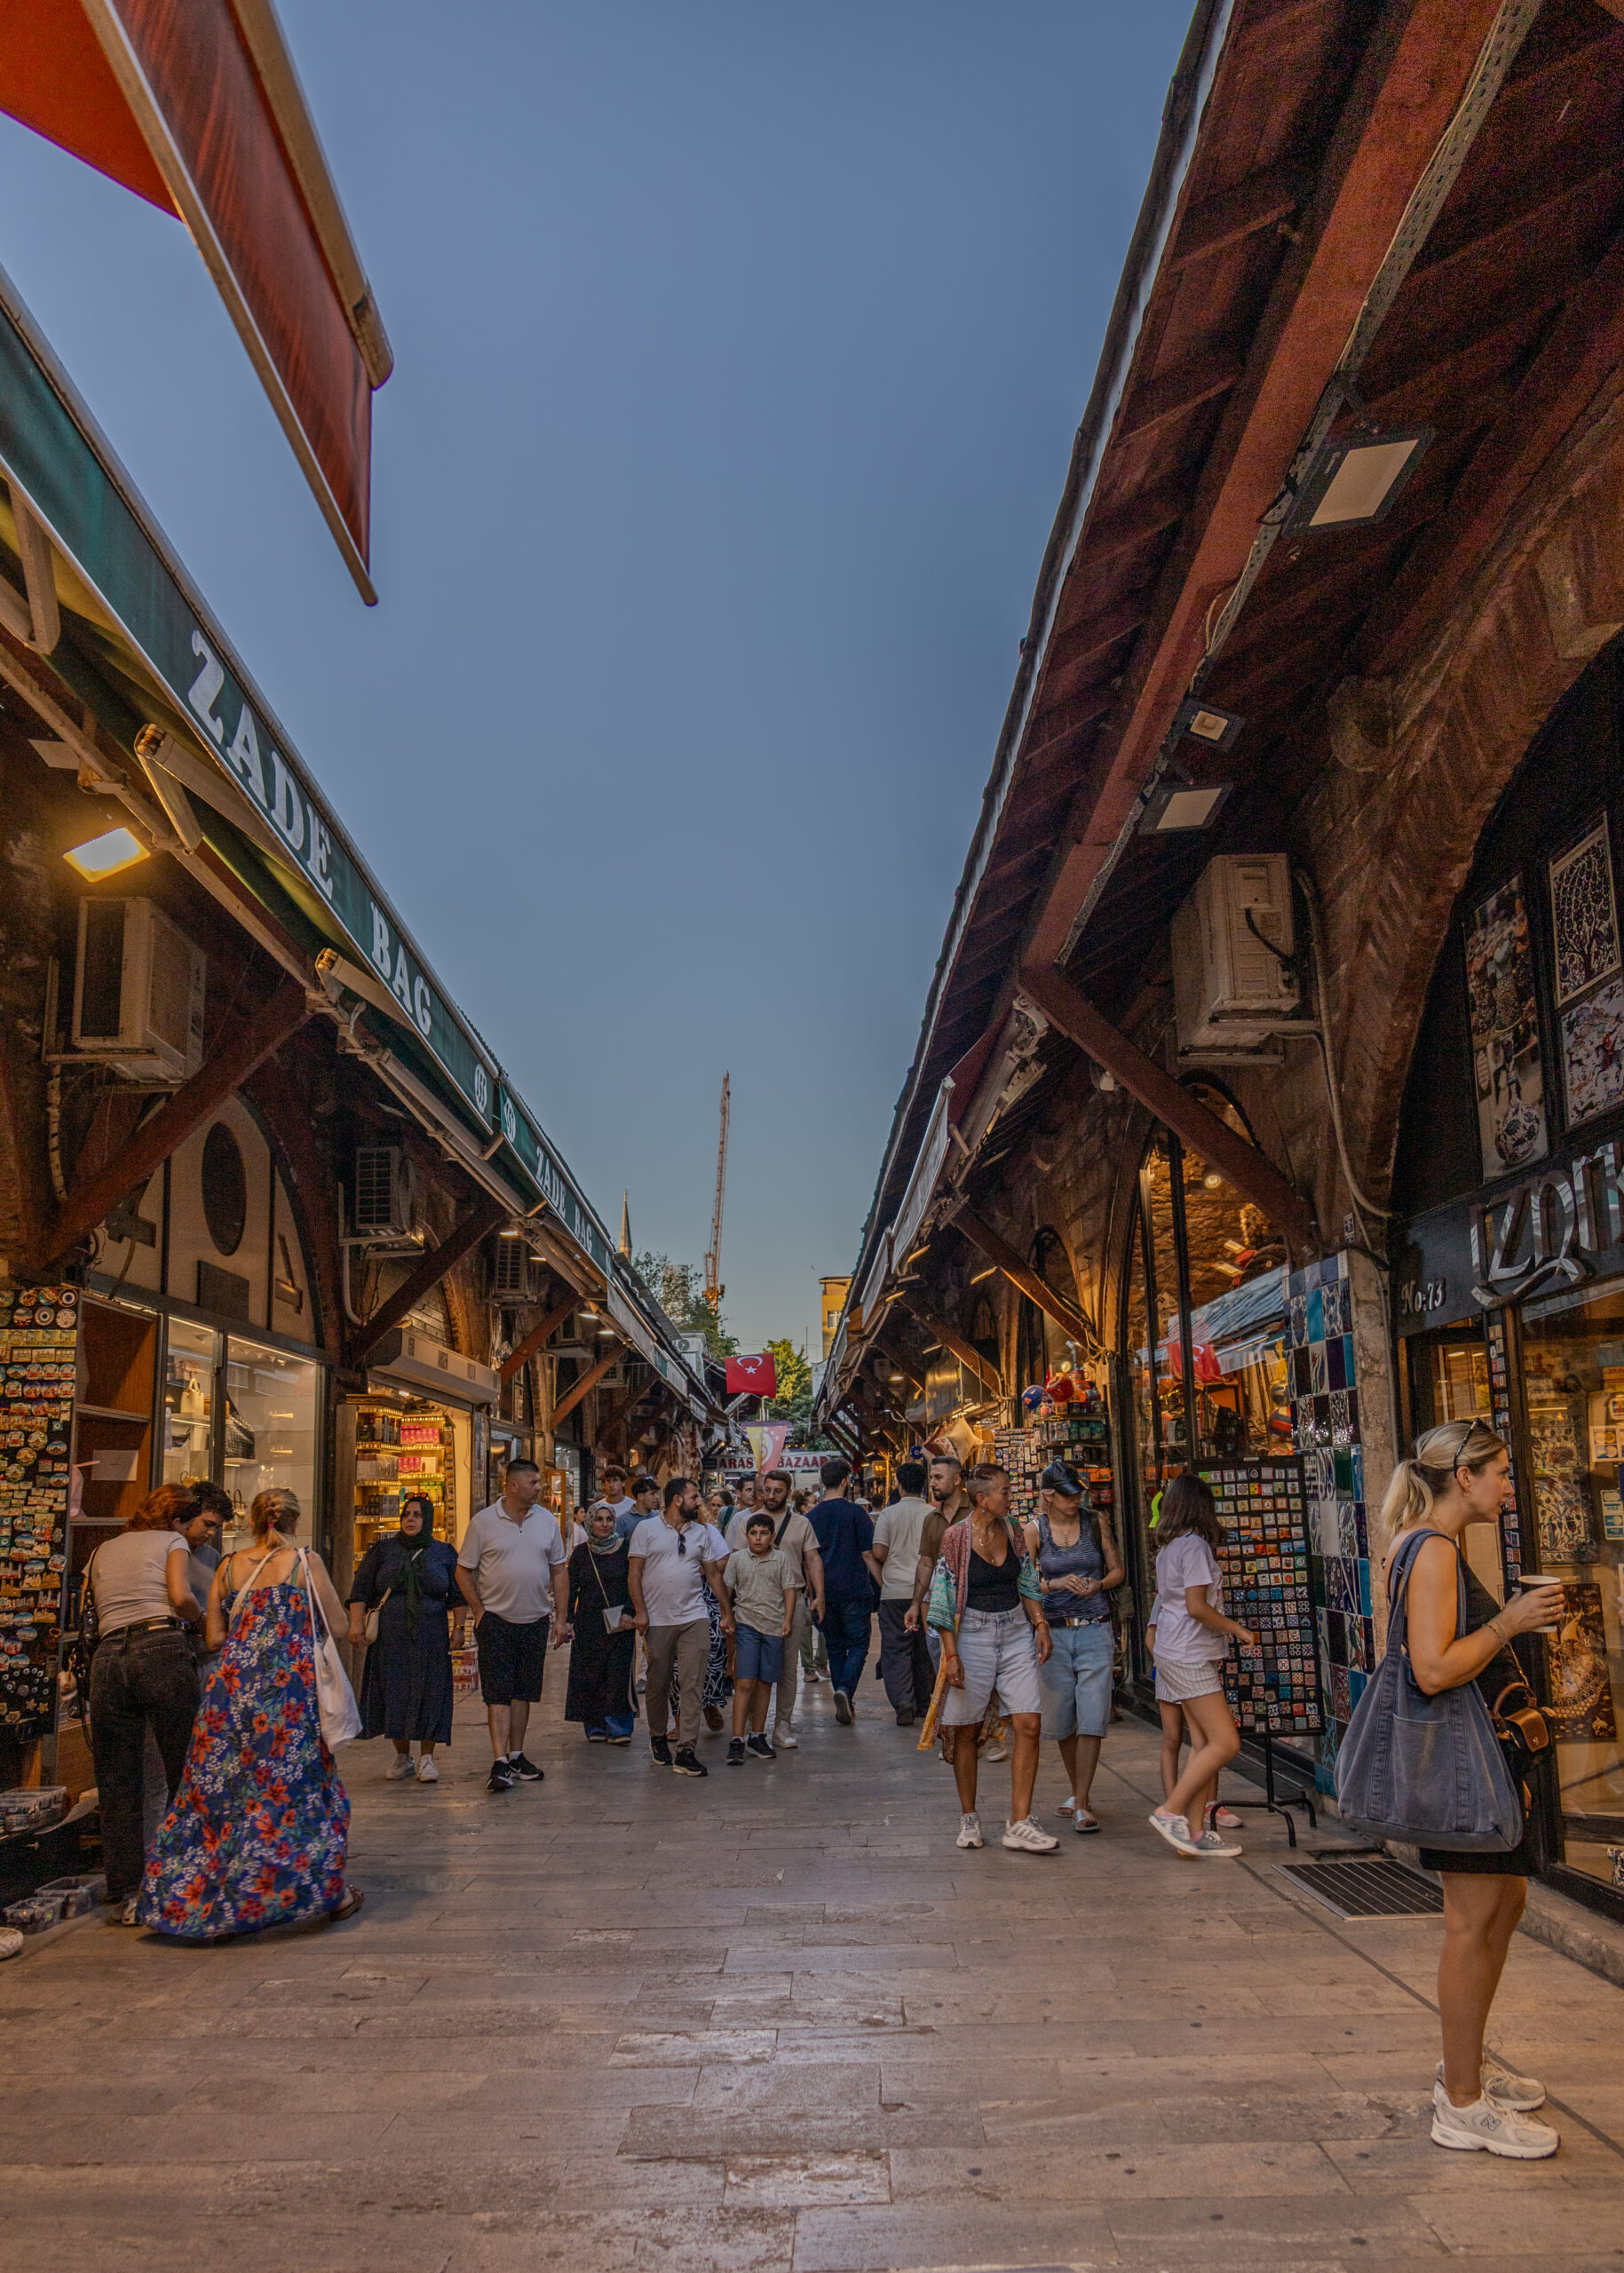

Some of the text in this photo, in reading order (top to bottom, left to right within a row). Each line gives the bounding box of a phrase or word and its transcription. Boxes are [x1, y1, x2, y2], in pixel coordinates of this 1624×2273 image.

[187, 630, 432, 1036] ZADE BAG
[536, 1145, 592, 1254] ZADE BAG
[717, 1457, 754, 1469] ARAS
